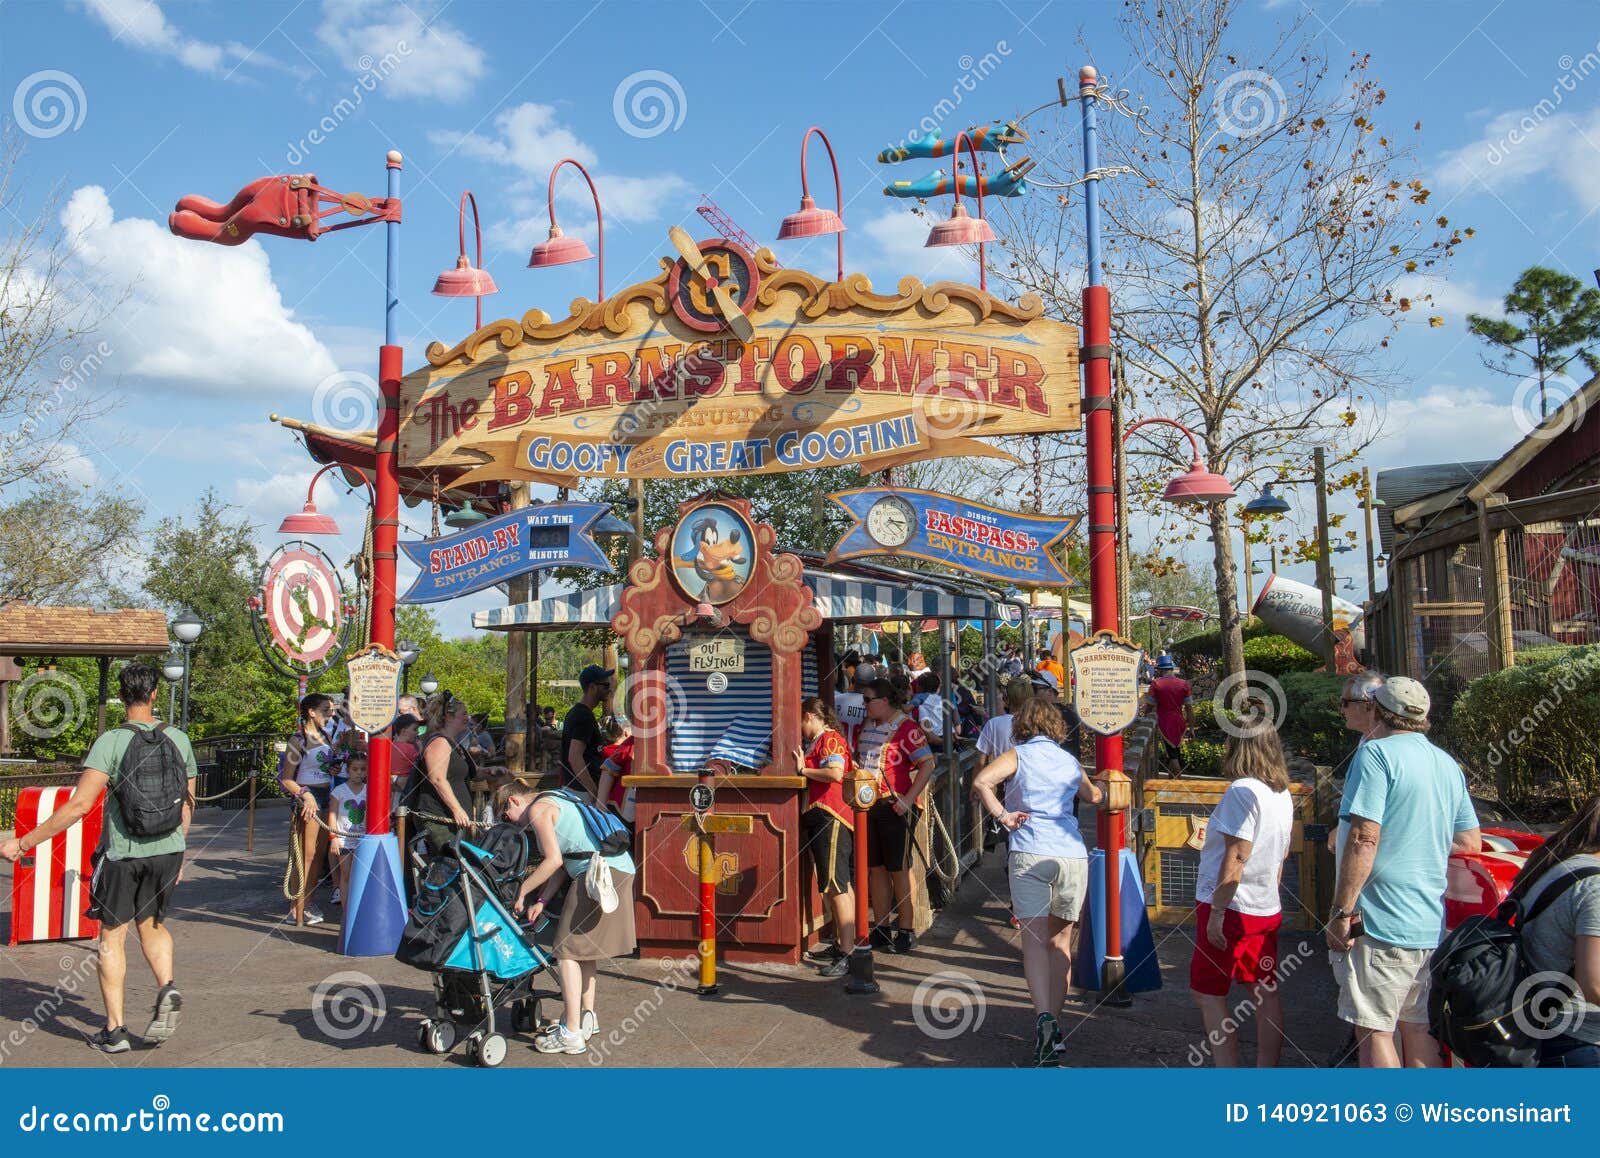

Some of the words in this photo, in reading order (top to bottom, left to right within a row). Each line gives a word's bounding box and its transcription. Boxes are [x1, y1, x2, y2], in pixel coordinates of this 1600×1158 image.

[413, 390, 479, 449] The
[487, 333, 1050, 432] BARNSTORMER
[645, 406, 784, 429] FEATURING
[527, 436, 633, 474] GOOFY
[664, 439, 771, 475] GREAT
[774, 413, 921, 464] GOOFINI
[527, 515, 548, 526] WAIT
[552, 514, 574, 524] TIME
[967, 510, 998, 523] DISNEY
[925, 508, 1039, 553] FASTPASS+
[429, 522, 520, 574] STAND-BY
[528, 550, 569, 560] MINUTES
[926, 532, 1039, 572] ENTRANCE
[434, 551, 521, 588] ENTRANCE
[700, 641, 722, 654] OUT
[1083, 653, 1136, 665] BARNSTORMER
[694, 654, 741, 669] FLYING!
